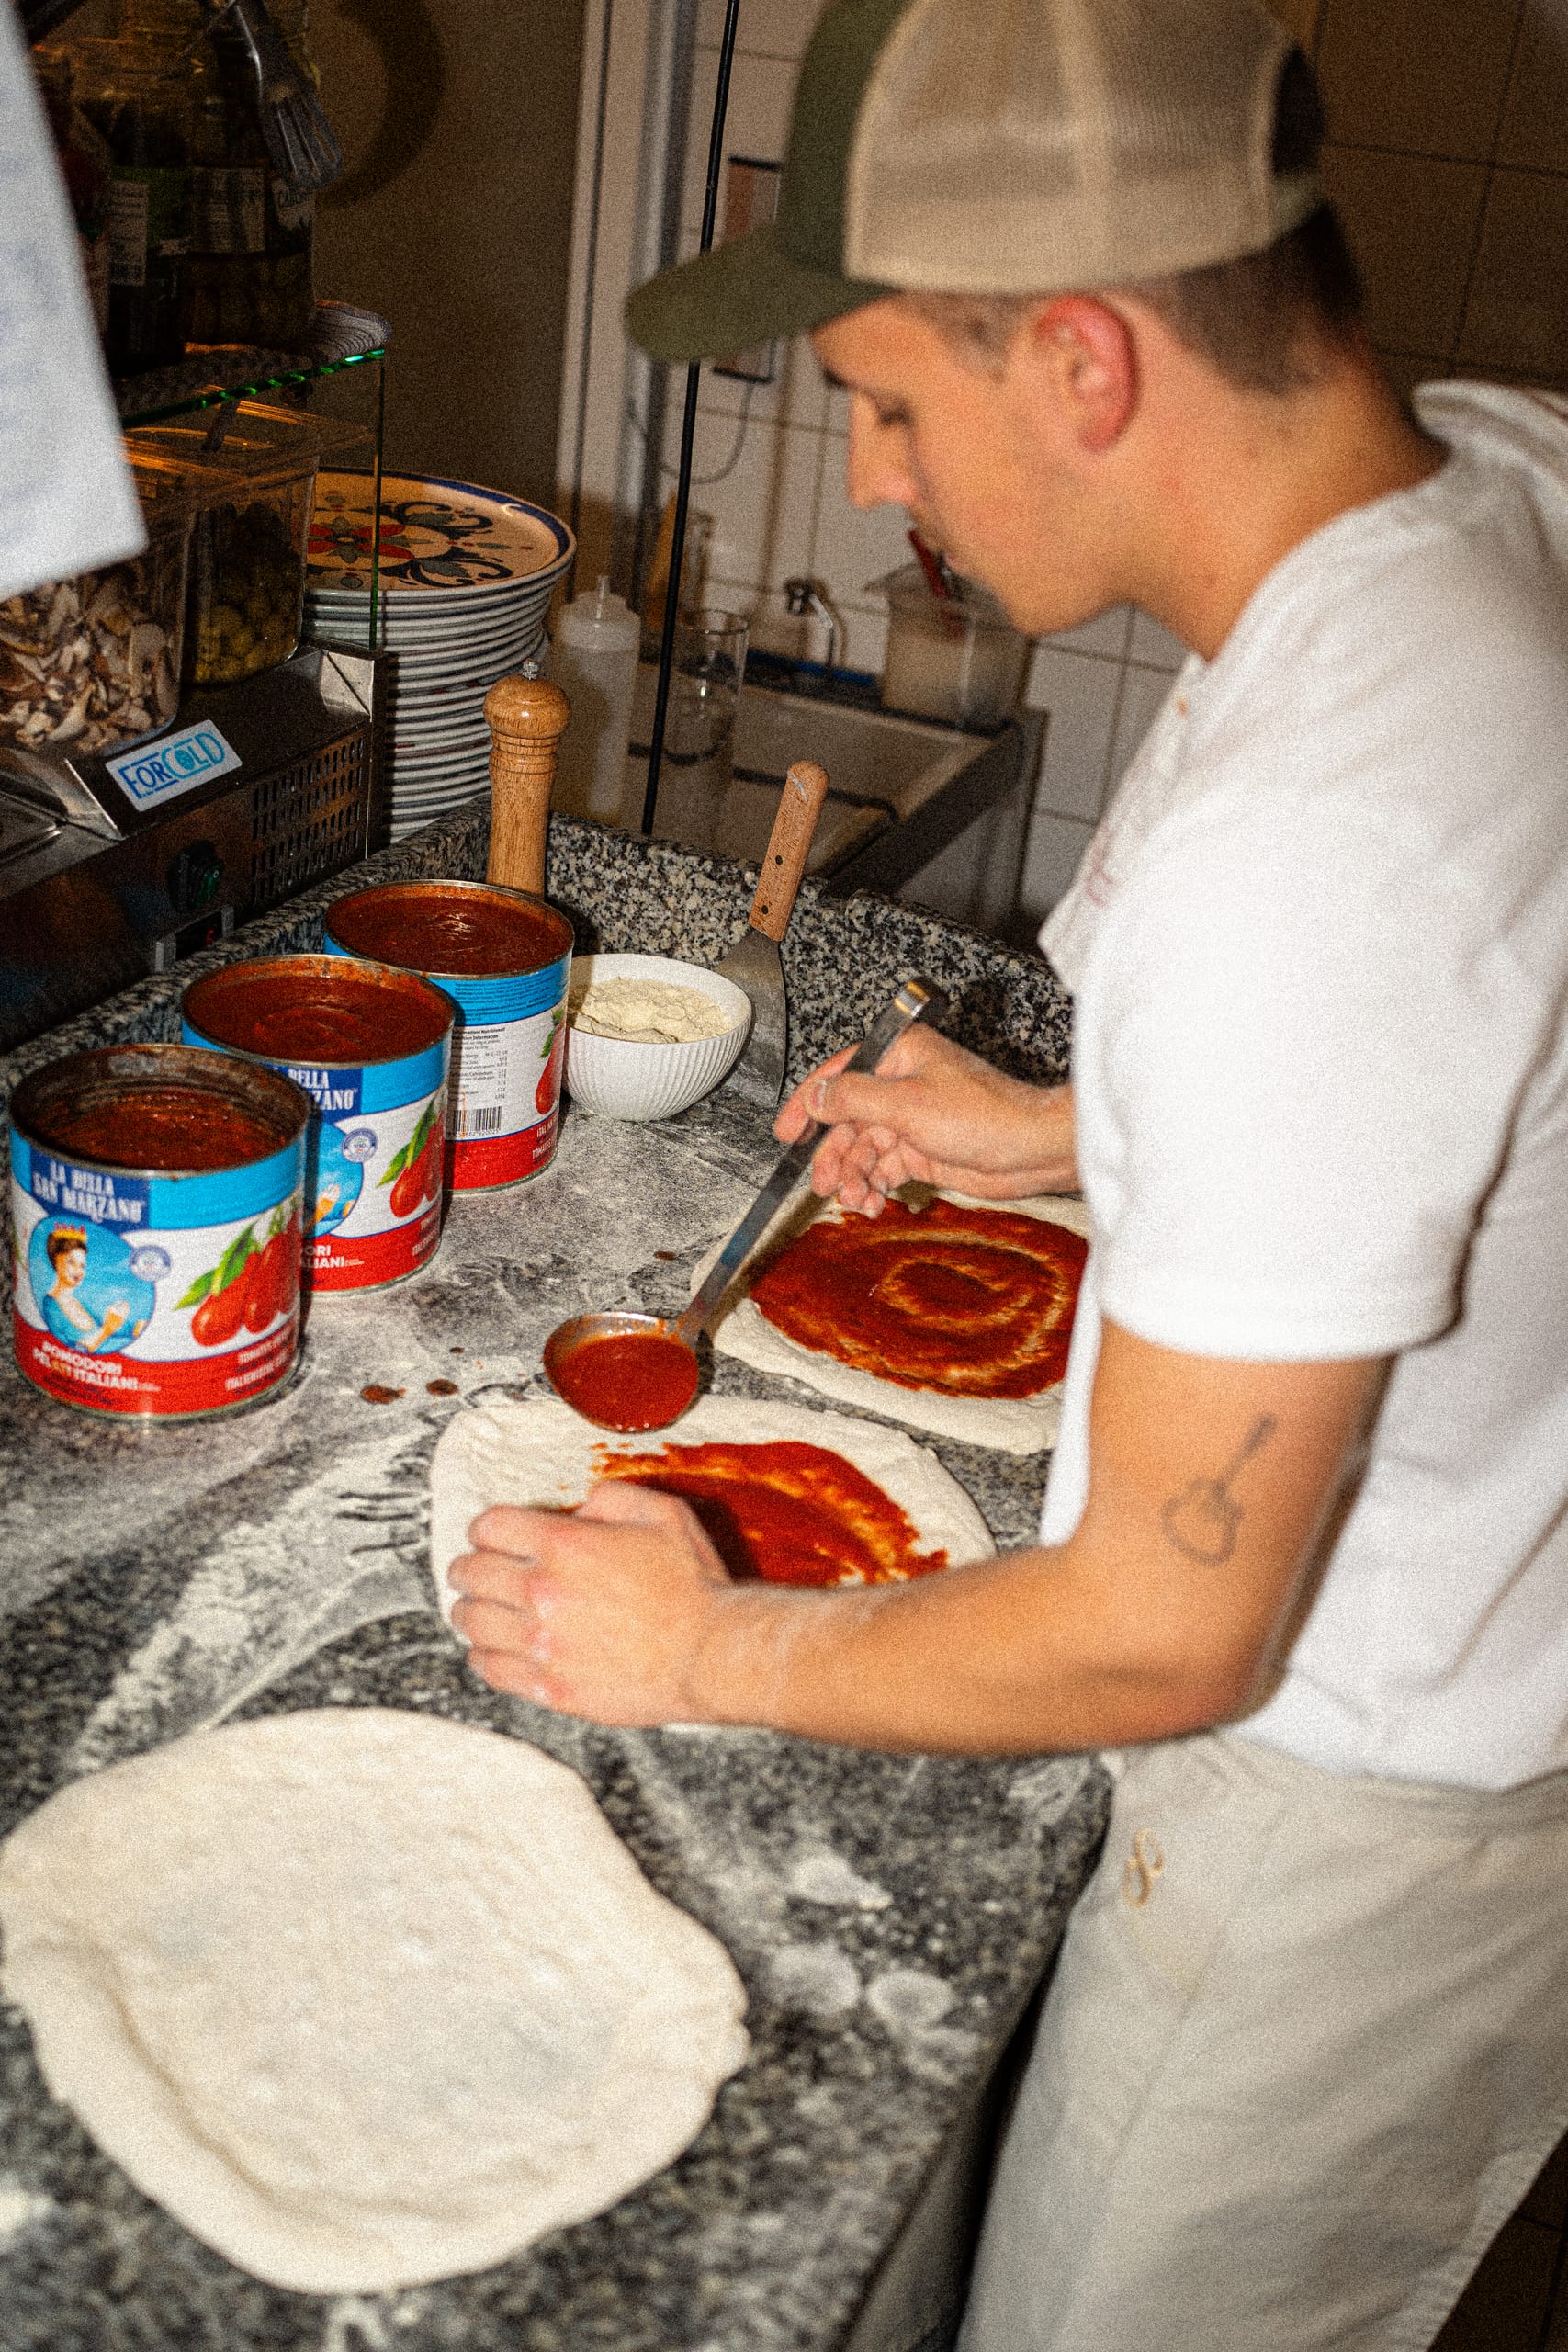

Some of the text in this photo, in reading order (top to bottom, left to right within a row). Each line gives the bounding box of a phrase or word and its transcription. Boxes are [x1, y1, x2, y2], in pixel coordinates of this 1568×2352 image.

[118, 732, 225, 799] FORCOLD
[33, 1171, 143, 1223] SAN MARZANO
[50, 1159, 115, 1197] LA BELLA
[42, 1340, 122, 1375] POMODORI
[73, 1368, 139, 1390] ITALIANI
